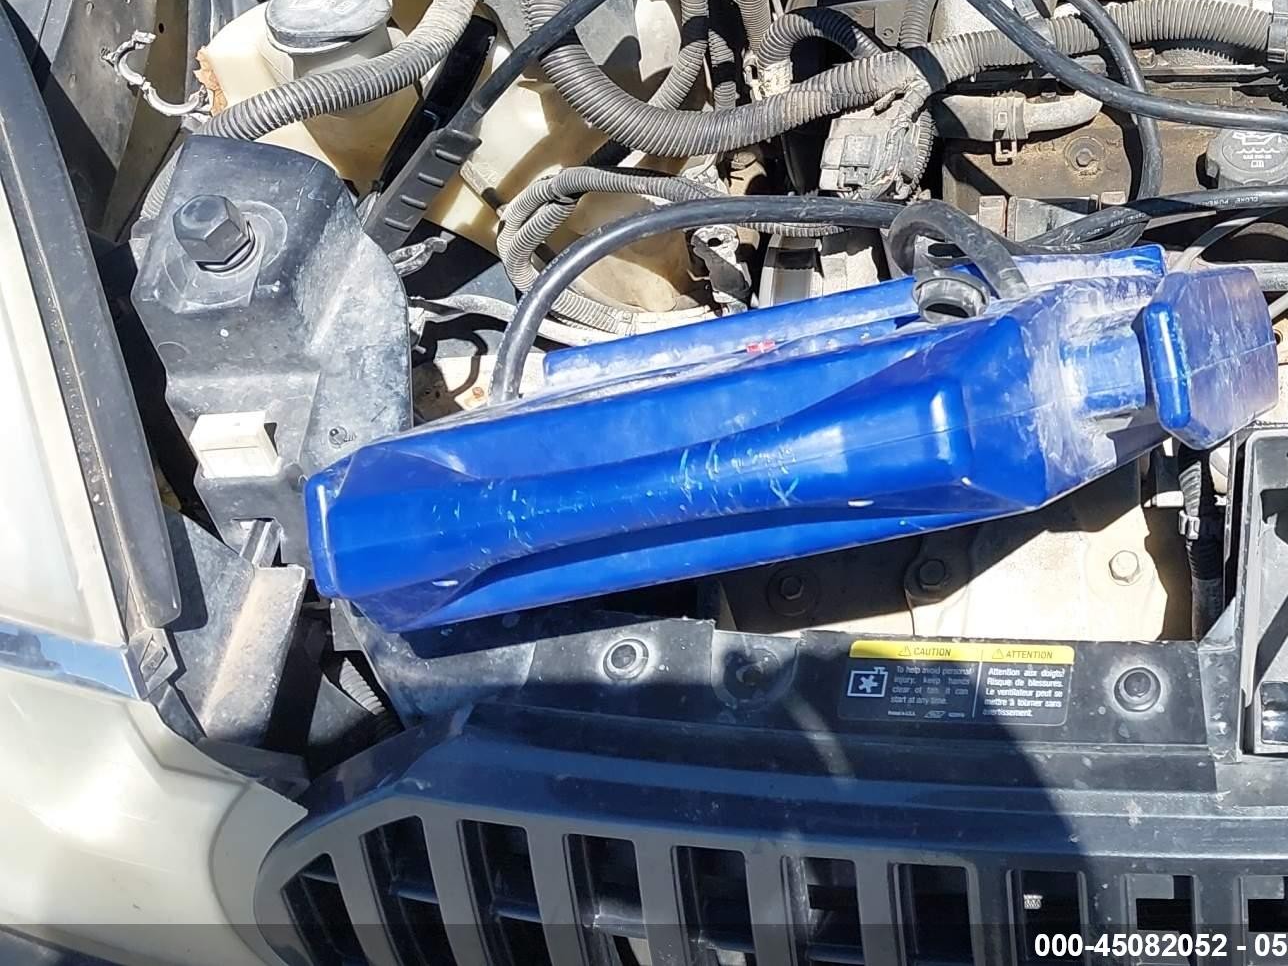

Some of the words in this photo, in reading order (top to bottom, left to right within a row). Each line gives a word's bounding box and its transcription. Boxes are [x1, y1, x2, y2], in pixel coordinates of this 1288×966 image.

[913, 647, 951, 657] CAUTION
[1005, 650, 1053, 660] ATTENTION
[906, 665, 921, 676] help
[922, 666, 941, 675] avoid
[942, 666, 973, 676] personal
[988, 667, 1020, 677] Attention
[1024, 669, 1038, 677] aux
[922, 676, 942, 686] keep
[986, 677, 1013, 688] Risque
[1014, 678, 1025, 687] de
[1027, 679, 1064, 688] blessures.
[891, 686, 910, 695] clear
[913, 686, 923, 694] of
[954, 688, 969, 696] can
[985, 688, 995, 696] Le
[996, 688, 1034, 698] ventilateur
[1035, 690, 1053, 699] peut
[890, 696, 906, 705] start
[906, 697, 915, 705] at
[916, 697, 930, 707] any
[984, 698, 1007, 707] mettre
[1016, 699, 1043, 708] tourner
[1044, 700, 1062, 708] sans
